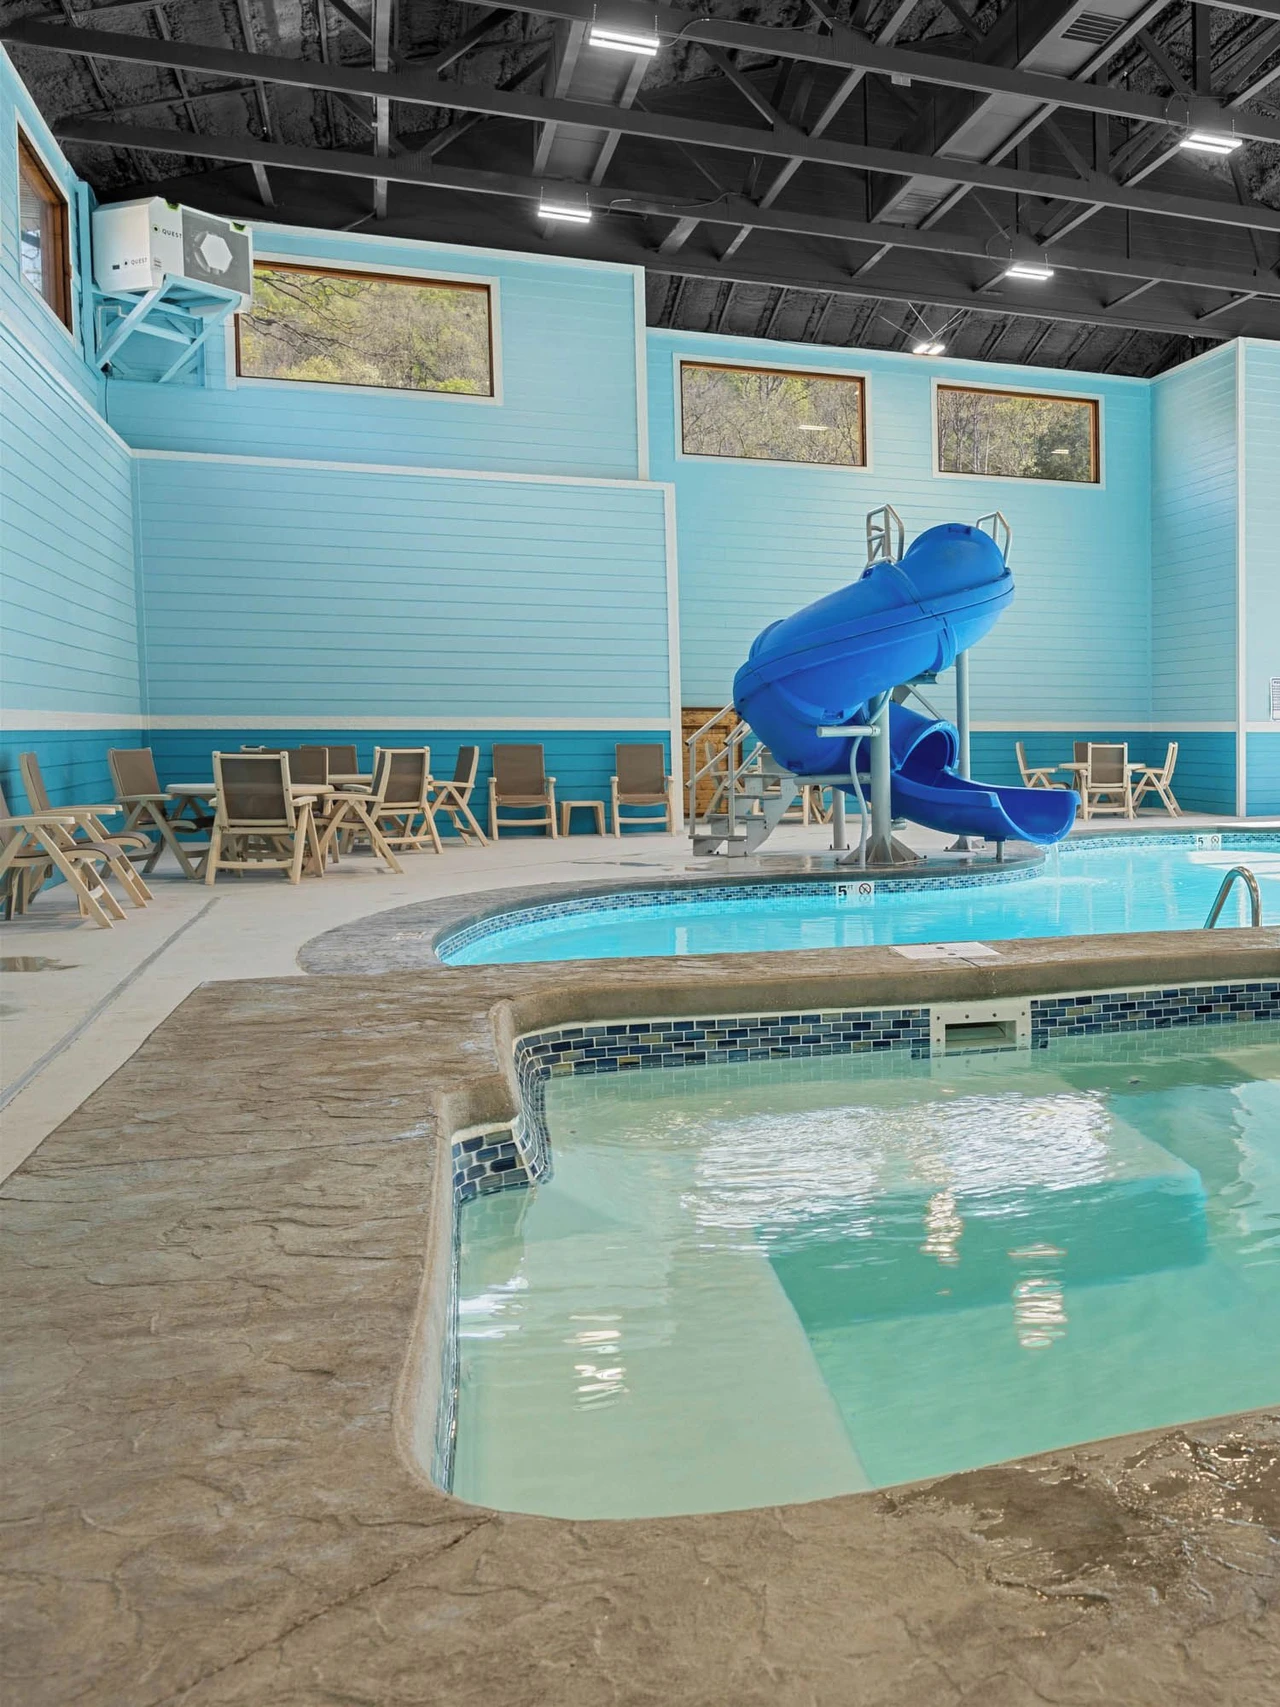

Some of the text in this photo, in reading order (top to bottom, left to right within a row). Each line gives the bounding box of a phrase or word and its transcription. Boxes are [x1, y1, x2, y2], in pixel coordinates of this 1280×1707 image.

[162, 228, 182, 238] QUEST
[131, 257, 148, 265] QUEST
[838, 885, 847, 896] 5
